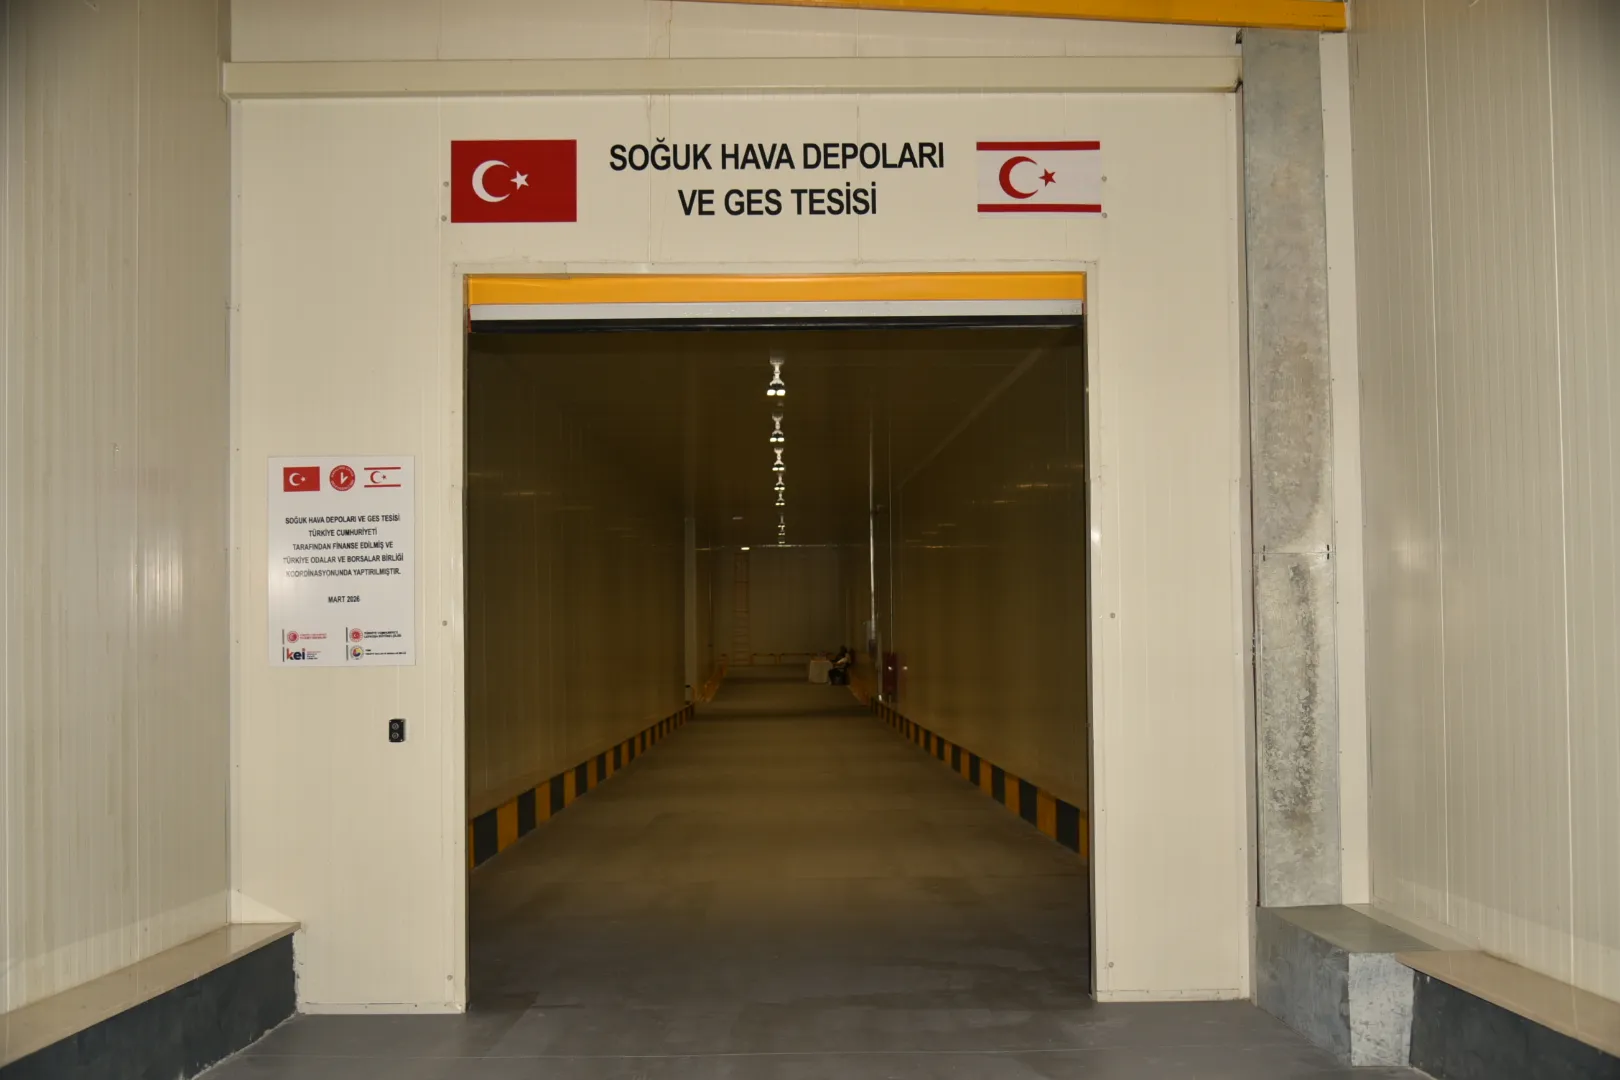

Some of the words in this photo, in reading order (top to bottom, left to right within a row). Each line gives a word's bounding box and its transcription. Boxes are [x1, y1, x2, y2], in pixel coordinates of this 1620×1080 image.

[609, 137, 712, 171] SOĞUK
[721, 143, 795, 170] HAVA
[803, 142, 944, 170] DEPOLARI
[678, 189, 715, 216] VE
[724, 188, 782, 216] GES
[791, 181, 877, 215] TESİSİ
[285, 516, 307, 524] SOĞUK
[382, 513, 400, 522] TESİSİ
[308, 528, 334, 537] TÜRKİYE
[336, 527, 378, 536] CUMHURİYETİ
[333, 542, 358, 550] FİNANSE
[360, 541, 384, 550] EDİLMİŞ
[283, 556, 309, 564] TÜRKİYE
[310, 556, 336, 564] ODALAR
[347, 554, 380, 562] BORSALAR
[382, 552, 404, 562] BİRLİĞİ
[286, 648, 306, 660] kei
